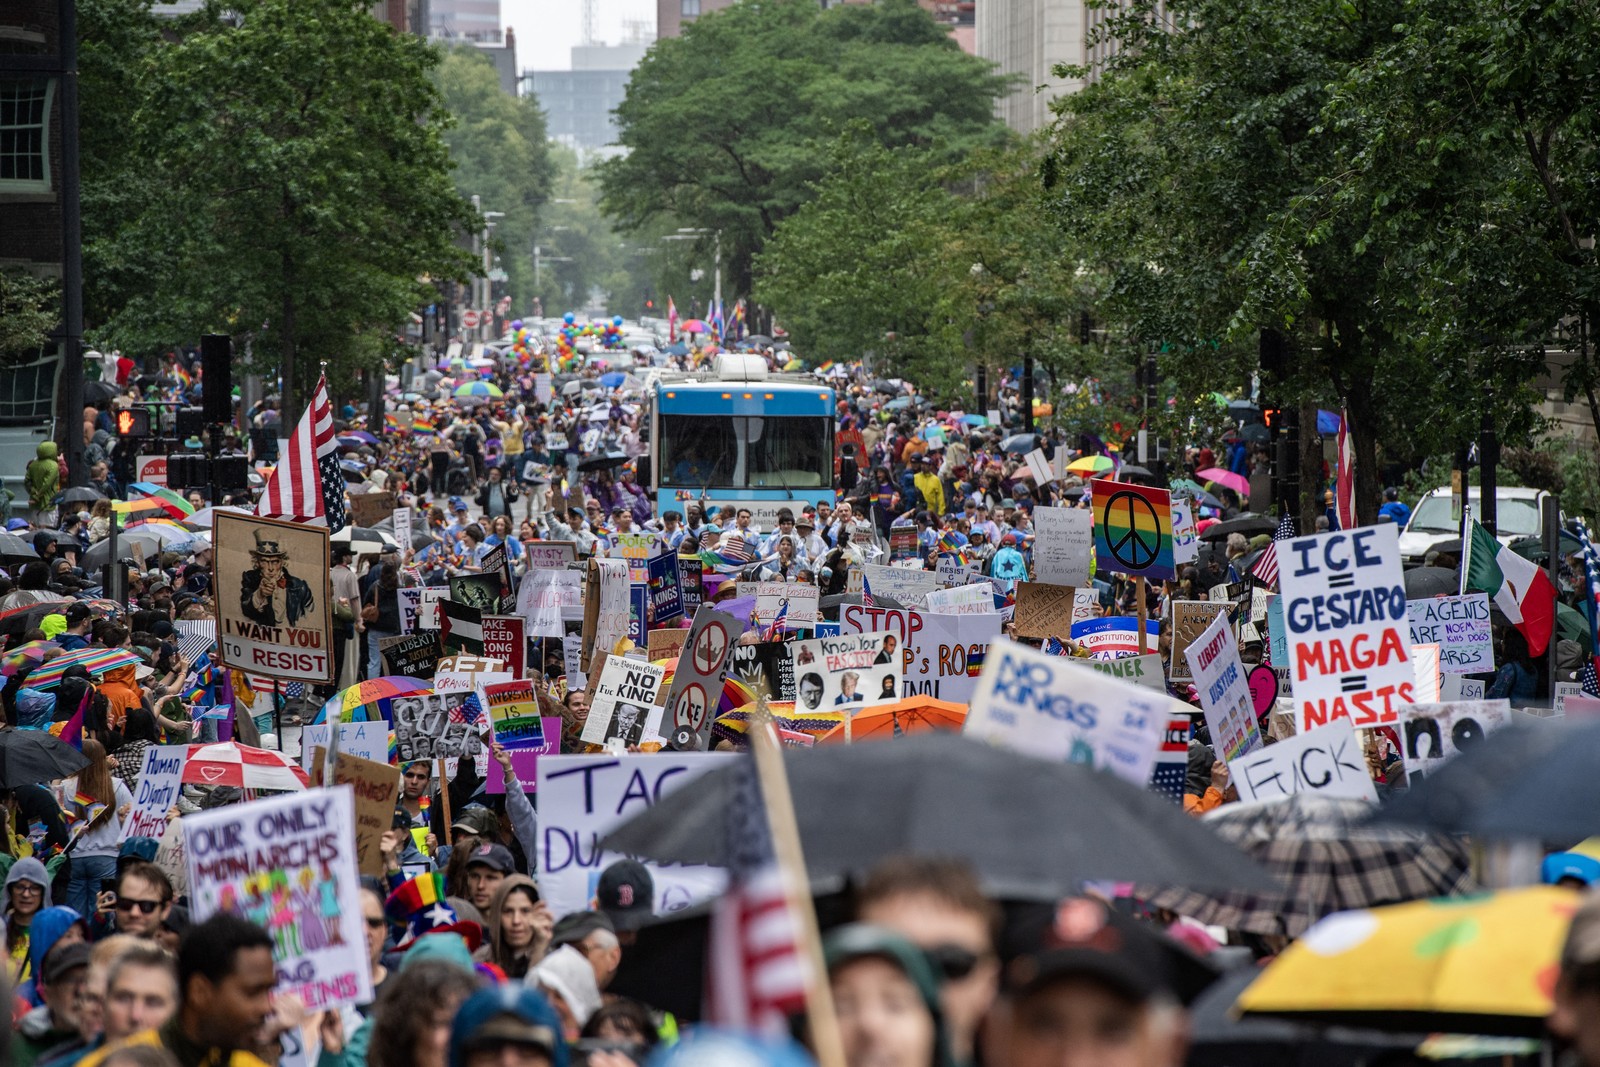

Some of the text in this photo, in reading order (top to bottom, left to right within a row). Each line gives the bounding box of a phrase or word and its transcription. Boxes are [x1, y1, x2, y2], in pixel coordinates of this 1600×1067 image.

[611, 534, 660, 549] PROTECT
[531, 548, 564, 559] KRISTY
[622, 547, 648, 558] OUR
[1292, 529, 1382, 577] ICE
[880, 570, 911, 581] STAND
[940, 566, 964, 574] RESIST
[655, 586, 678, 606] KINGS
[758, 583, 816, 598] RESPECT EXISTENCE
[1031, 584, 1052, 601] KINGS
[1019, 604, 1034, 618] YAS
[1034, 589, 1064, 610] QUEENS
[1200, 604, 1216, 613] TIME
[1288, 585, 1406, 634] GESTAPO
[1425, 600, 1489, 622] AGENTS
[845, 605, 923, 647] STOP
[1095, 624, 1112, 632] HAVE
[1182, 616, 1208, 624] A NEW
[225, 619, 320, 648] I WANT YOU
[398, 630, 435, 654] LIBERTY
[484, 630, 514, 640] REED
[596, 634, 616, 650] OUT
[1089, 634, 1137, 644] CONSTITUTION
[1410, 625, 1442, 644] ARE
[1446, 622, 1474, 634] NOEM
[1468, 634, 1489, 642] DOGS
[397, 645, 434, 667] AND JUSTICE
[736, 644, 756, 660] NO
[820, 638, 856, 656] Know
[1102, 652, 1111, 660] A
[1197, 628, 1226, 672] LIBERTY
[1296, 627, 1408, 682] MAGA
[225, 642, 326, 672] TO RESIST
[437, 657, 504, 672] GET
[403, 660, 432, 675] FOR ALL
[610, 658, 662, 676] The Boston Globe
[999, 654, 1054, 688] NO
[1094, 658, 1144, 678] POWER
[625, 670, 656, 688] NO
[1208, 662, 1238, 706] JUSTICE
[486, 688, 535, 706] DIVERSITY
[599, 684, 655, 704] Fuc KING
[504, 705, 520, 720] IS
[680, 701, 702, 722] ICE
[993, 681, 1098, 730] KINGS
[355, 724, 366, 740] A
[397, 702, 480, 750] CULT
[1244, 736, 1361, 800] FUCK
[138, 780, 174, 813] Dignity
[191, 797, 331, 856] OUR ONLY
[197, 833, 339, 881] MONARCHS
